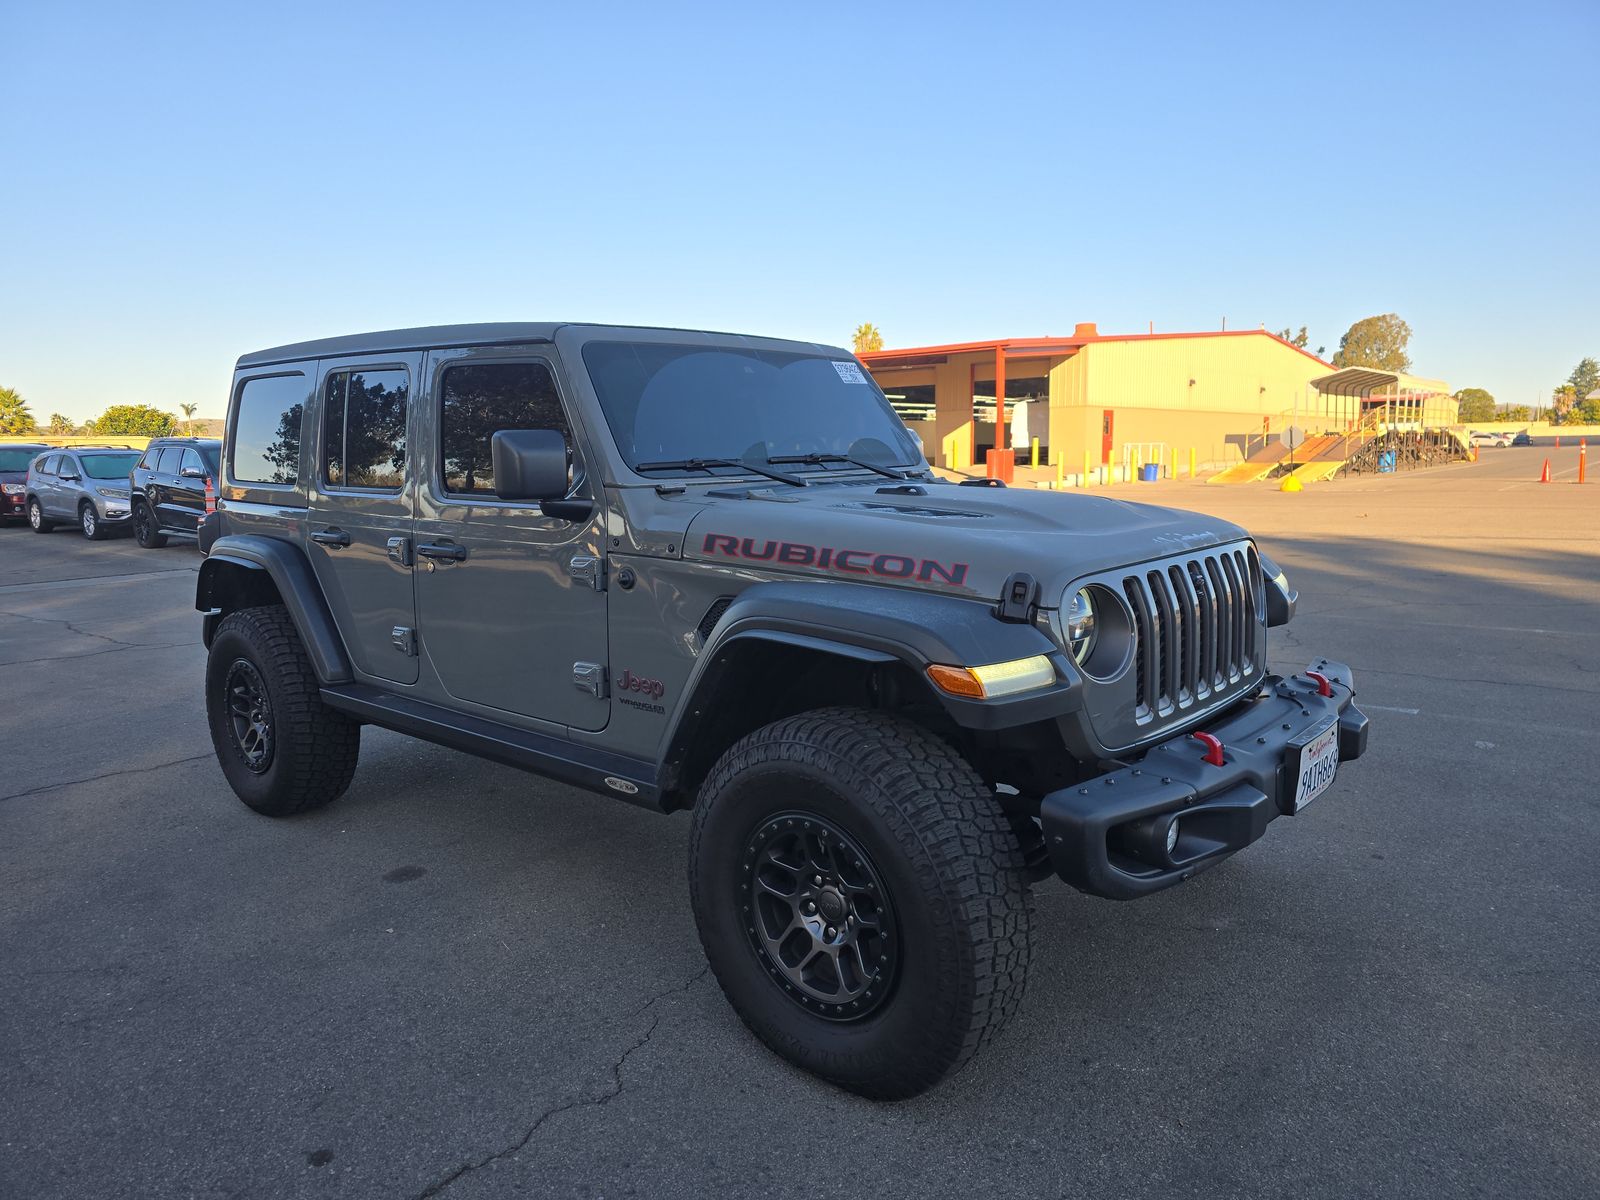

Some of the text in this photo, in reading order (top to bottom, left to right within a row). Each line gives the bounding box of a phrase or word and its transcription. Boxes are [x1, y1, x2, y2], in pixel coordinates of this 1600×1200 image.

[702, 535, 969, 586] RUBICON
[616, 669, 665, 700] Jeep
[619, 697, 665, 712] WRANGLER
